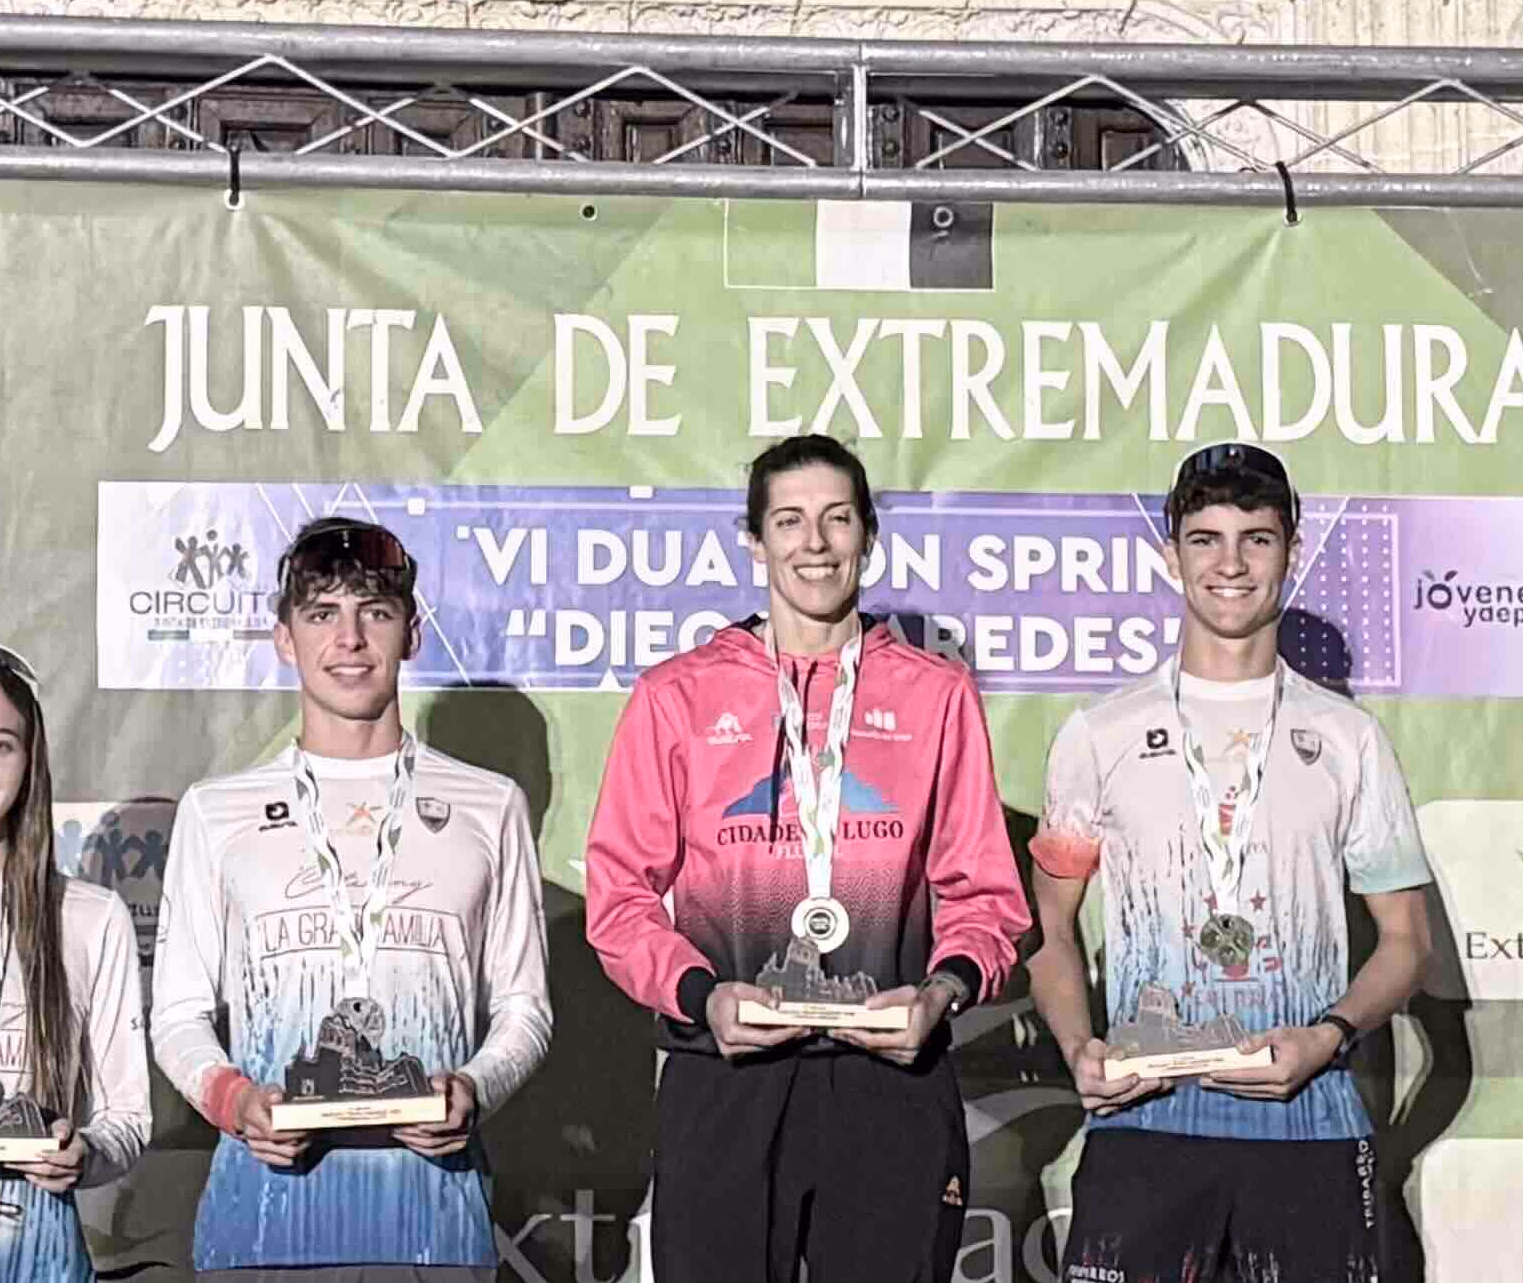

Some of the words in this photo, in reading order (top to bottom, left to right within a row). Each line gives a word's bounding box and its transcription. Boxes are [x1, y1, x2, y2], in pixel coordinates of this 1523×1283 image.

[145, 305, 484, 453] JUNTA
[554, 312, 681, 436] DE
[474, 528, 547, 586] VI
[578, 528, 939, 590] DUAN
[967, 534, 1184, 594] SPRIN
[505, 609, 769, 667] “DIE
[842, 820, 904, 841] LUGO
[298, 911, 364, 945] GRA
[383, 913, 442, 948] AMILIA
